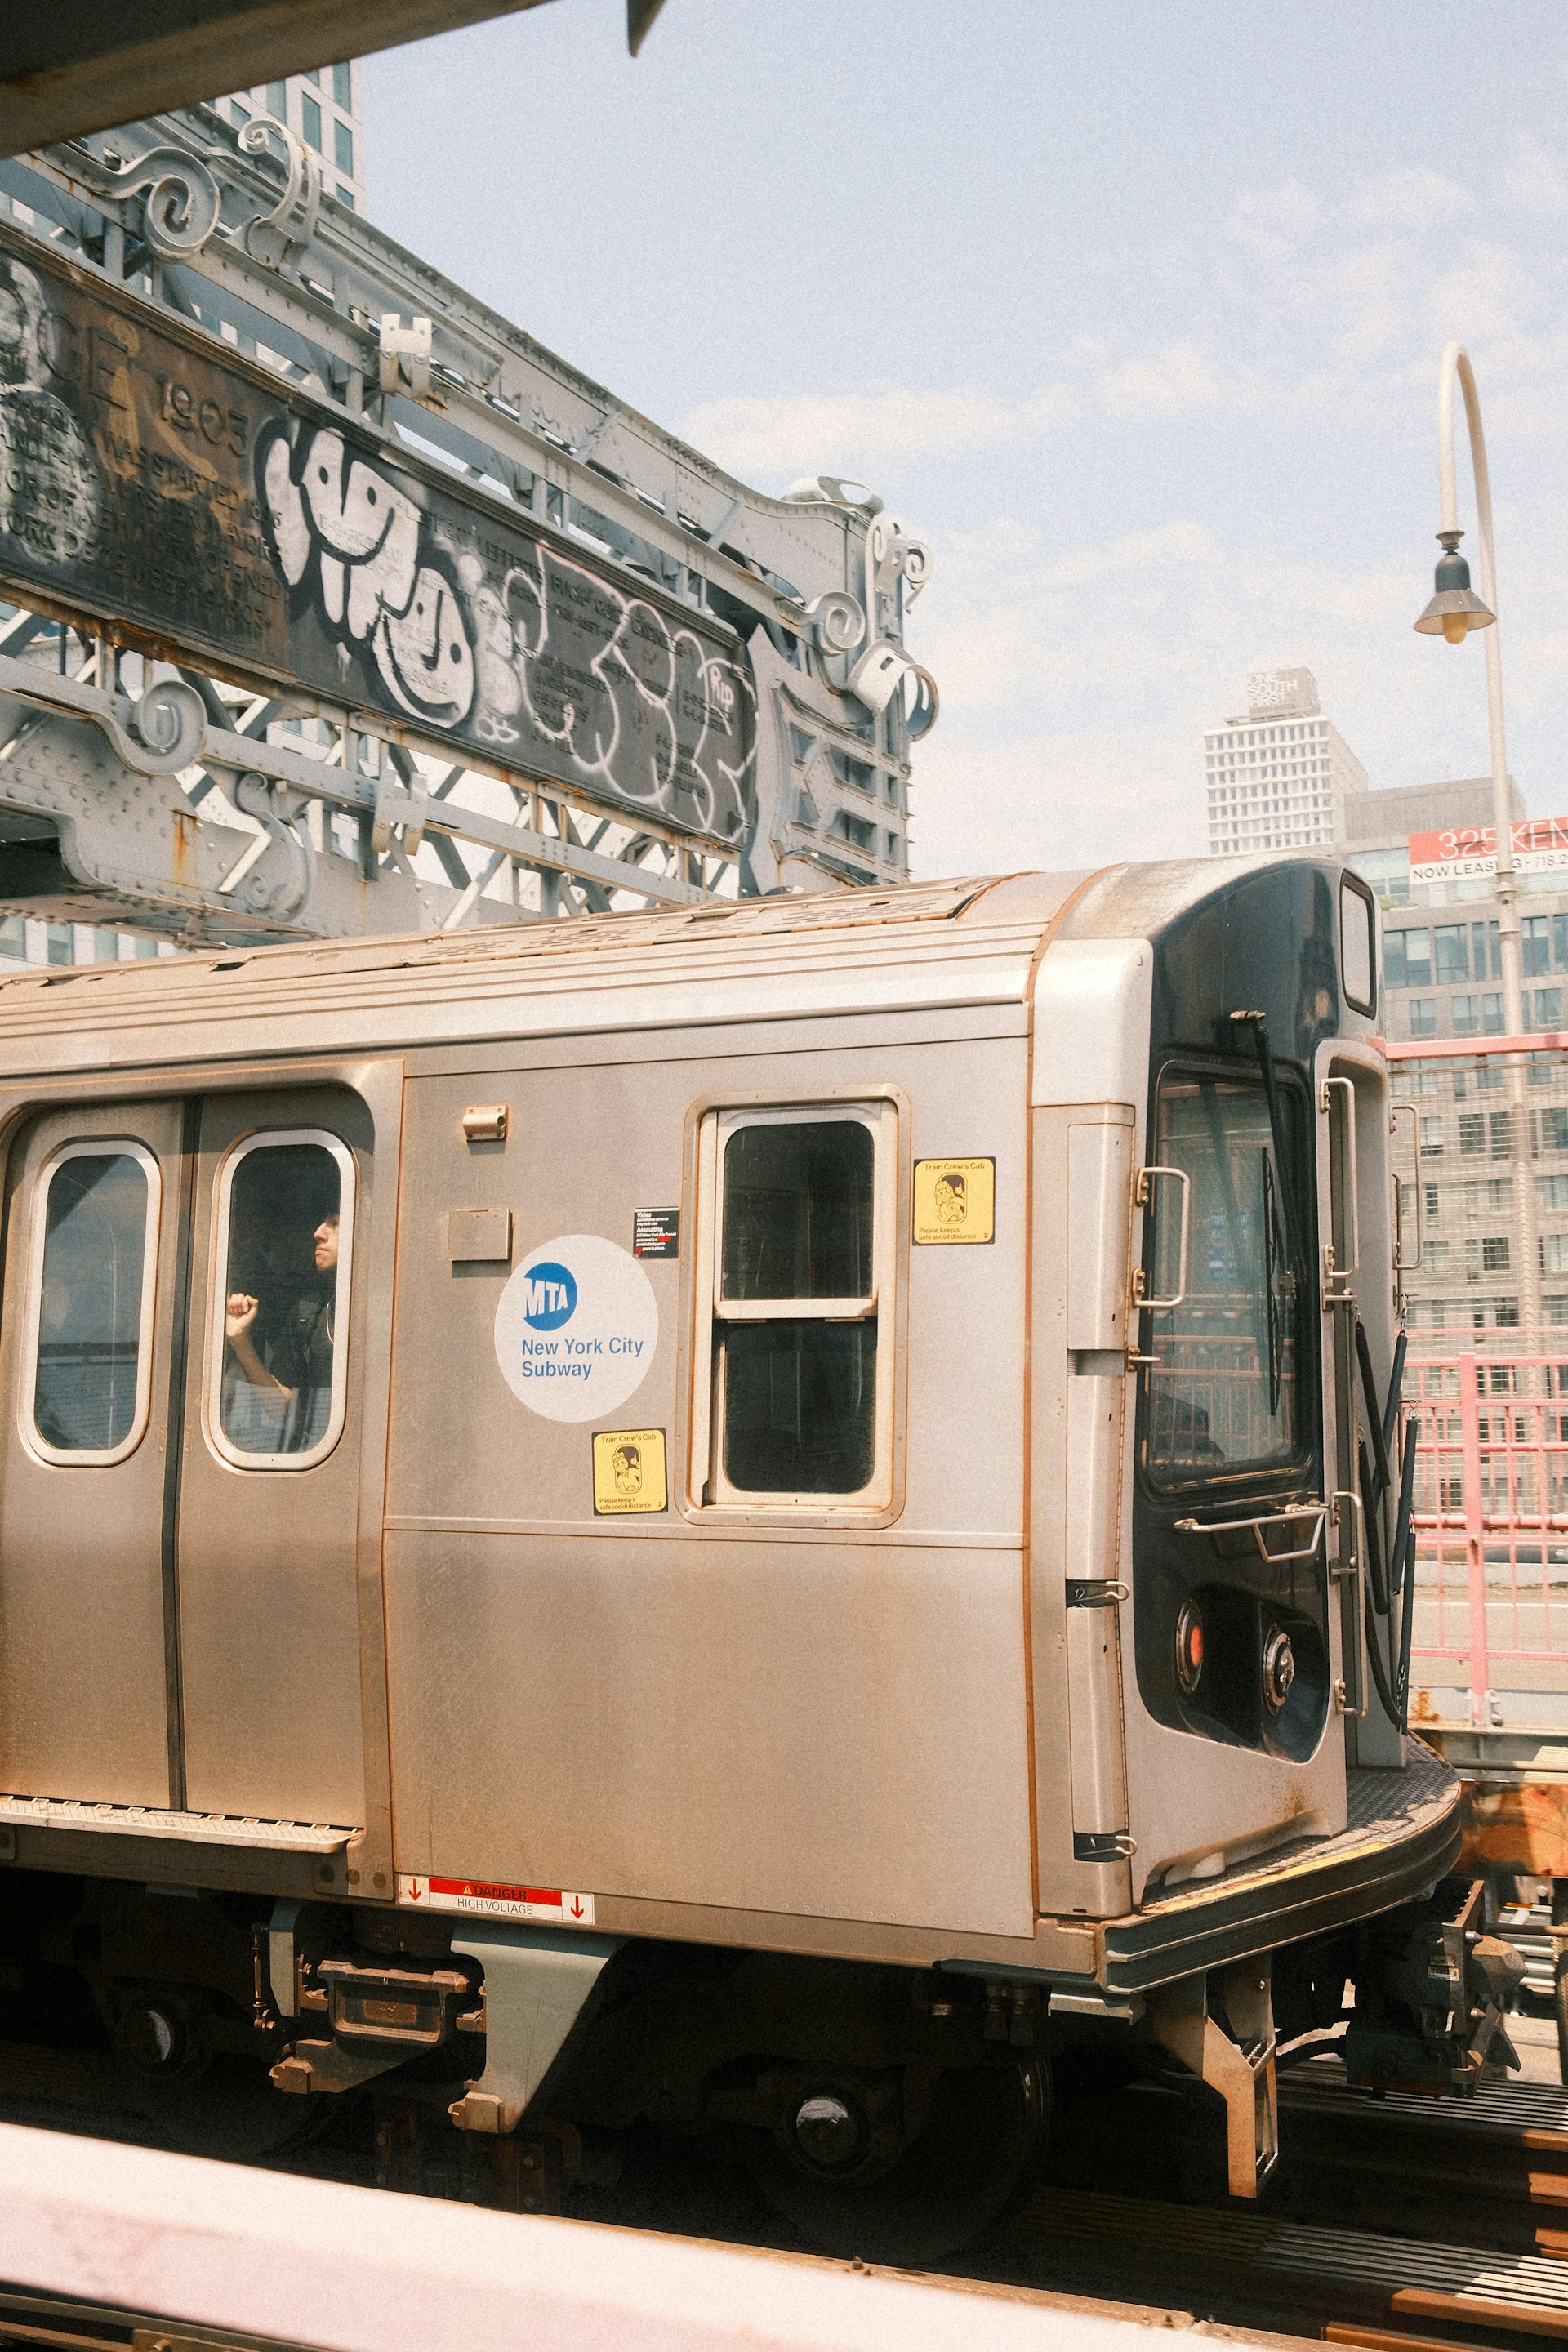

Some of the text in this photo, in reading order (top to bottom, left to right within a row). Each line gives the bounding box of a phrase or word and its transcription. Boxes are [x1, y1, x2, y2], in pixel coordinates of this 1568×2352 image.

[150, 368, 240, 450] 1903
[1250, 671, 1277, 685] ONE
[1249, 679, 1297, 696] SOUTH
[1250, 692, 1288, 707] FIRST
[1439, 827, 1497, 859] 325
[1414, 866, 1450, 880] NOW
[523, 1278, 568, 1316] MTA
[522, 1337, 644, 1357] New York City
[522, 1361, 592, 1381] Subway
[474, 1885, 527, 1900] DANGER
[457, 1897, 532, 1915] HIGH VOLTAGE
